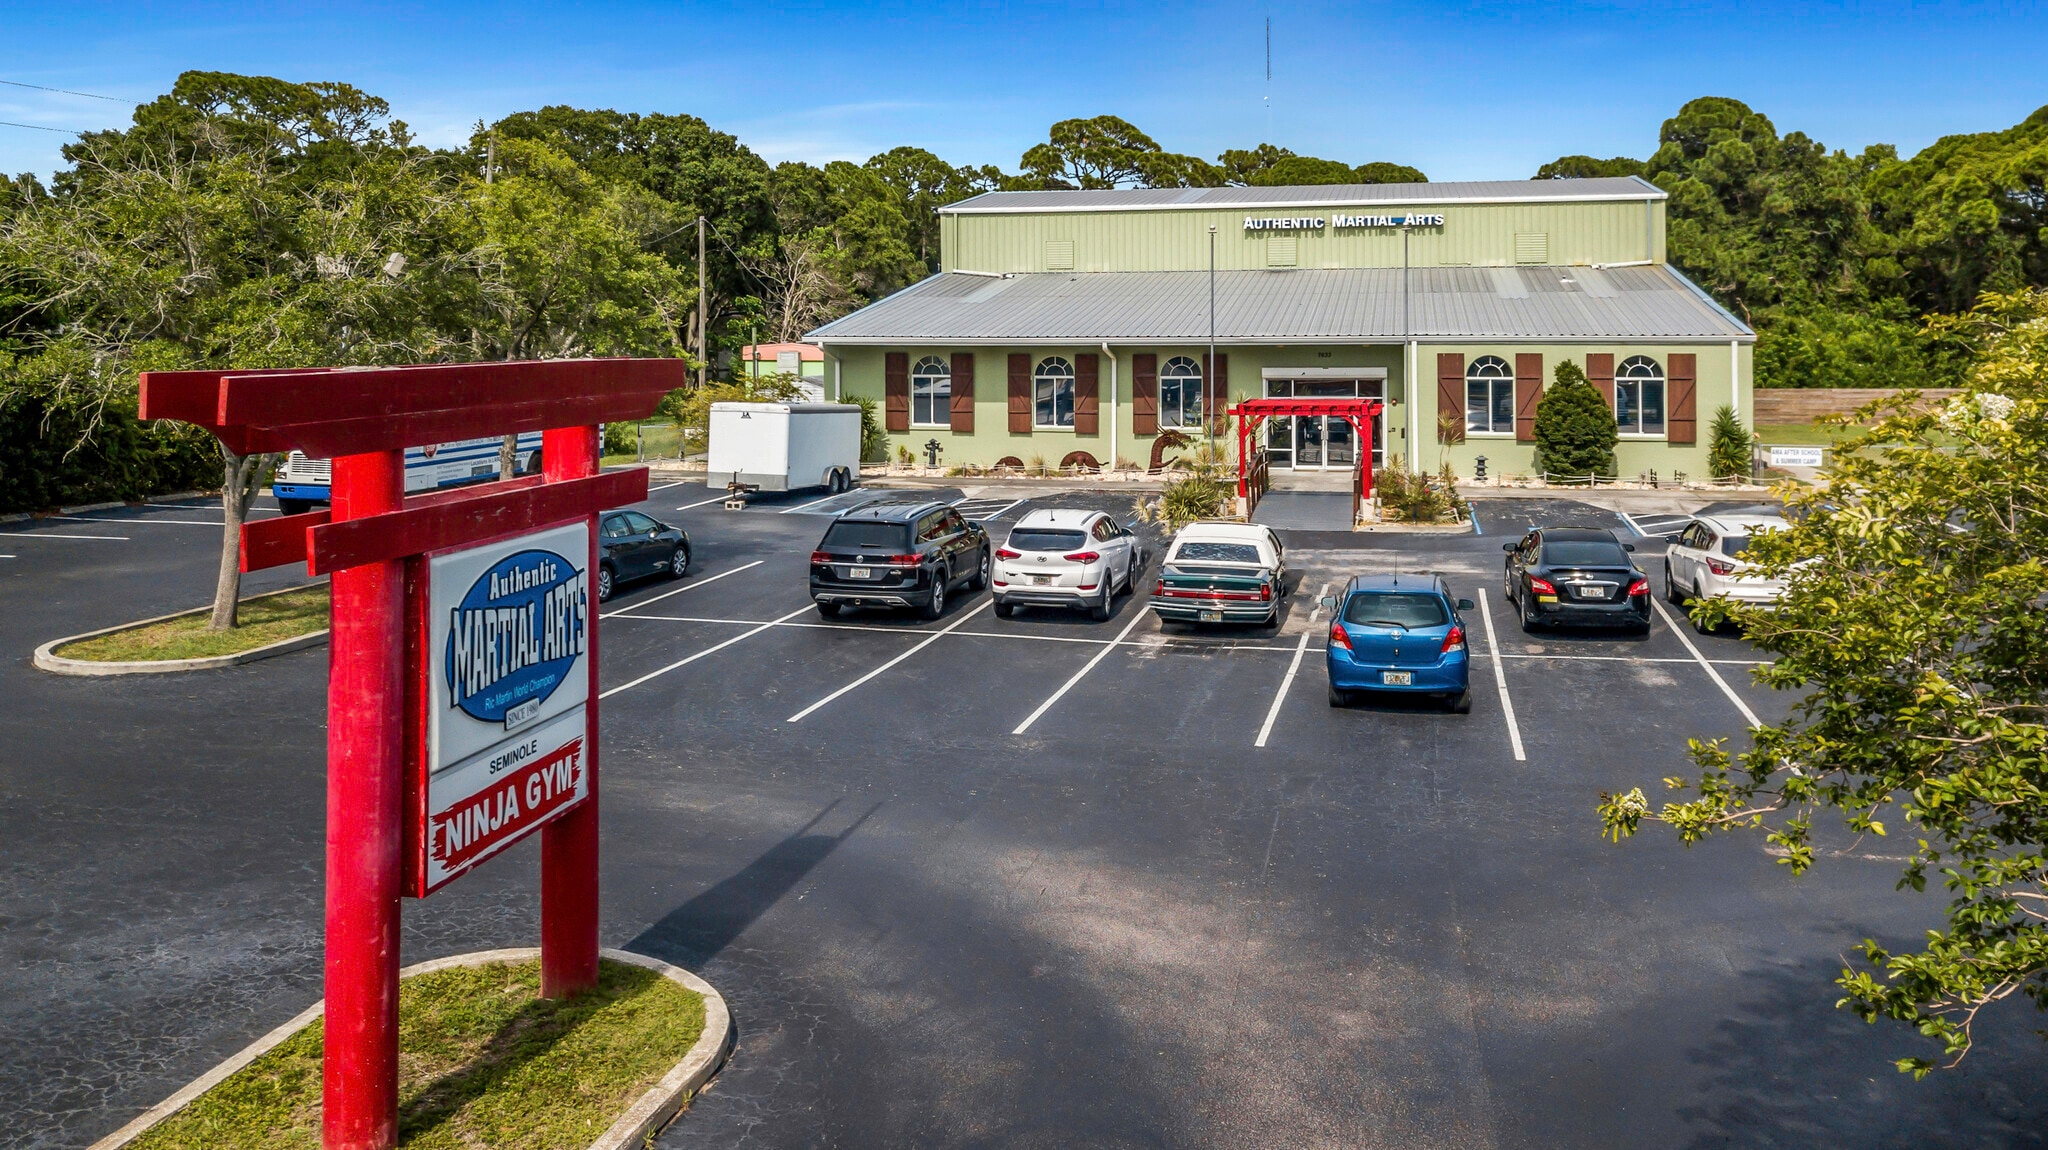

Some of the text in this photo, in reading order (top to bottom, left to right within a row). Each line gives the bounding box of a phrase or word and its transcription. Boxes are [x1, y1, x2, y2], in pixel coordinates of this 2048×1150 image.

[490, 558, 557, 600] Authentic
[453, 571, 587, 706] MARTIAL ARTS
[484, 674, 556, 711] Ric Martin World Champion
[507, 707, 526, 726] SINCE
[489, 739, 538, 775] SEMINOLE
[445, 754, 573, 858] NINJA GYM
